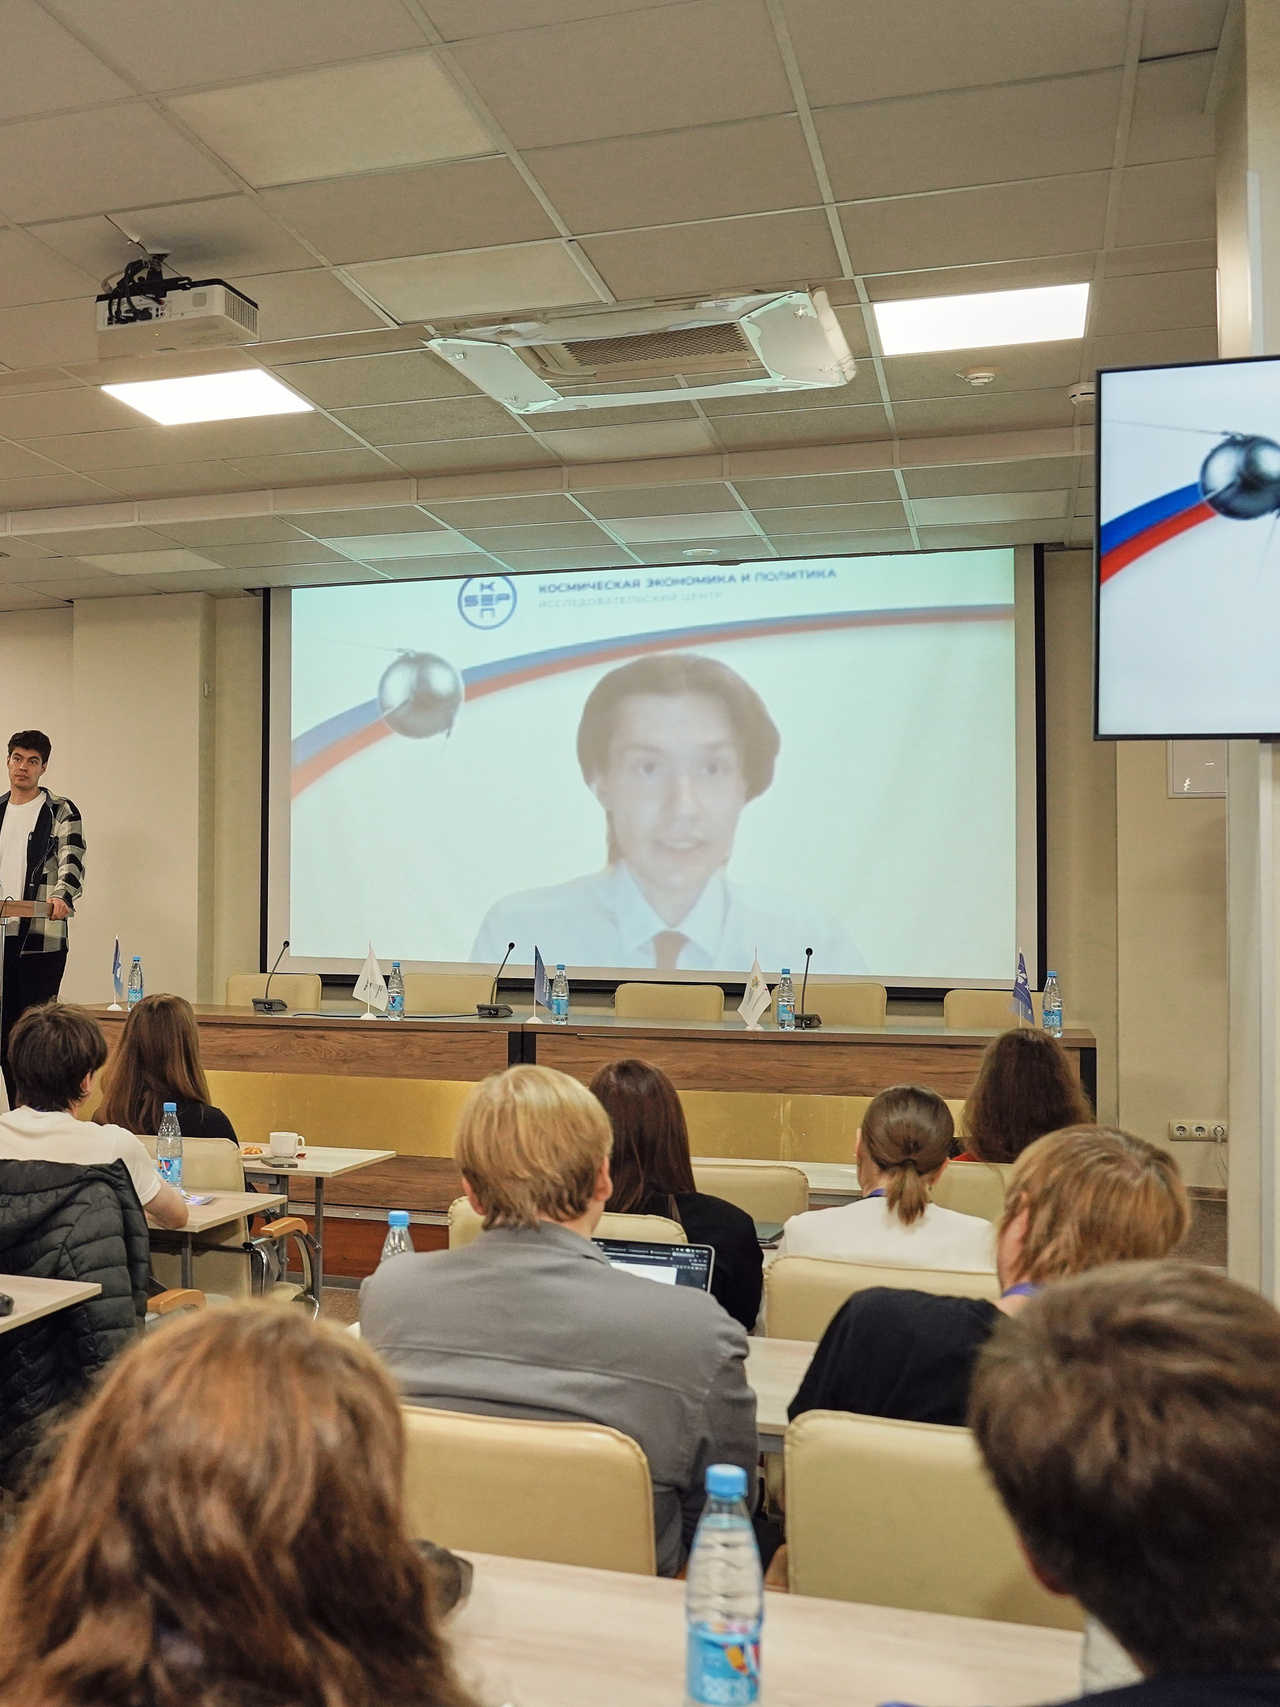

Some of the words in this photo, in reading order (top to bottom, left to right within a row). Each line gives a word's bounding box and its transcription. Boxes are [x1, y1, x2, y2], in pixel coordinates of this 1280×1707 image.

[538, 579, 641, 594] КОСМИЧЕСКАЯ
[646, 573, 736, 588] ЭКОНОМИКА
[741, 574, 750, 583] И
[755, 568, 837, 582] ПОЛИТИКА
